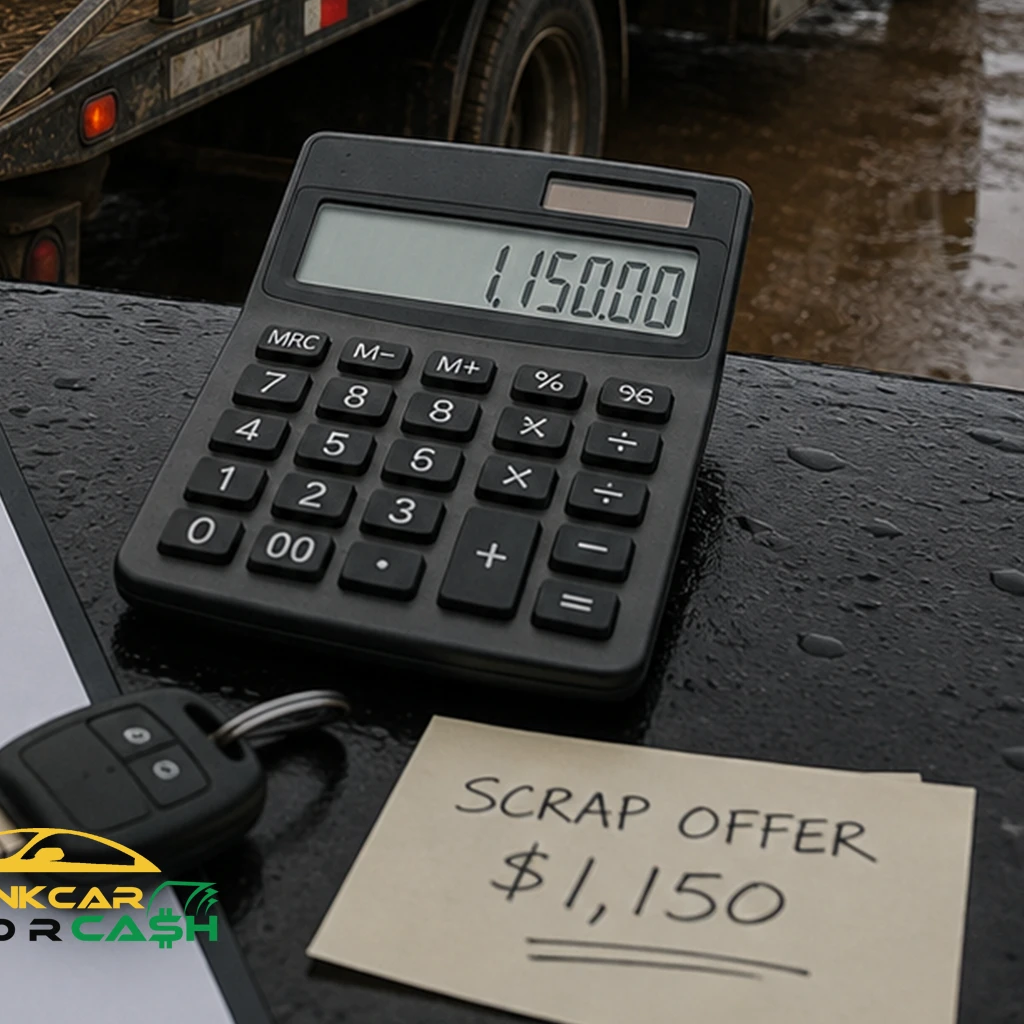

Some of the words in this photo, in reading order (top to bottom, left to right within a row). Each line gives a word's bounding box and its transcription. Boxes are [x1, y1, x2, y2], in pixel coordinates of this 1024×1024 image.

[485, 245, 685, 329] 1,150.00
[268, 330, 319, 349] MRC
[437, 356, 479, 374] M+
[535, 371, 563, 391] %
[261, 371, 286, 392] 7
[344, 386, 368, 408] 8
[429, 400, 453, 422] 8
[236, 419, 260, 440] 4
[323, 432, 349, 455] 5
[411, 448, 435, 471] 6
[220, 467, 235, 490] 1
[299, 482, 326, 507] 2
[389, 498, 415, 523] 3
[188, 517, 215, 544] 0
[267, 532, 314, 562] 00
[456, 777, 650, 830] SCRAP
[678, 806, 876, 862] OFFER
[491, 843, 785, 925] $1,150
